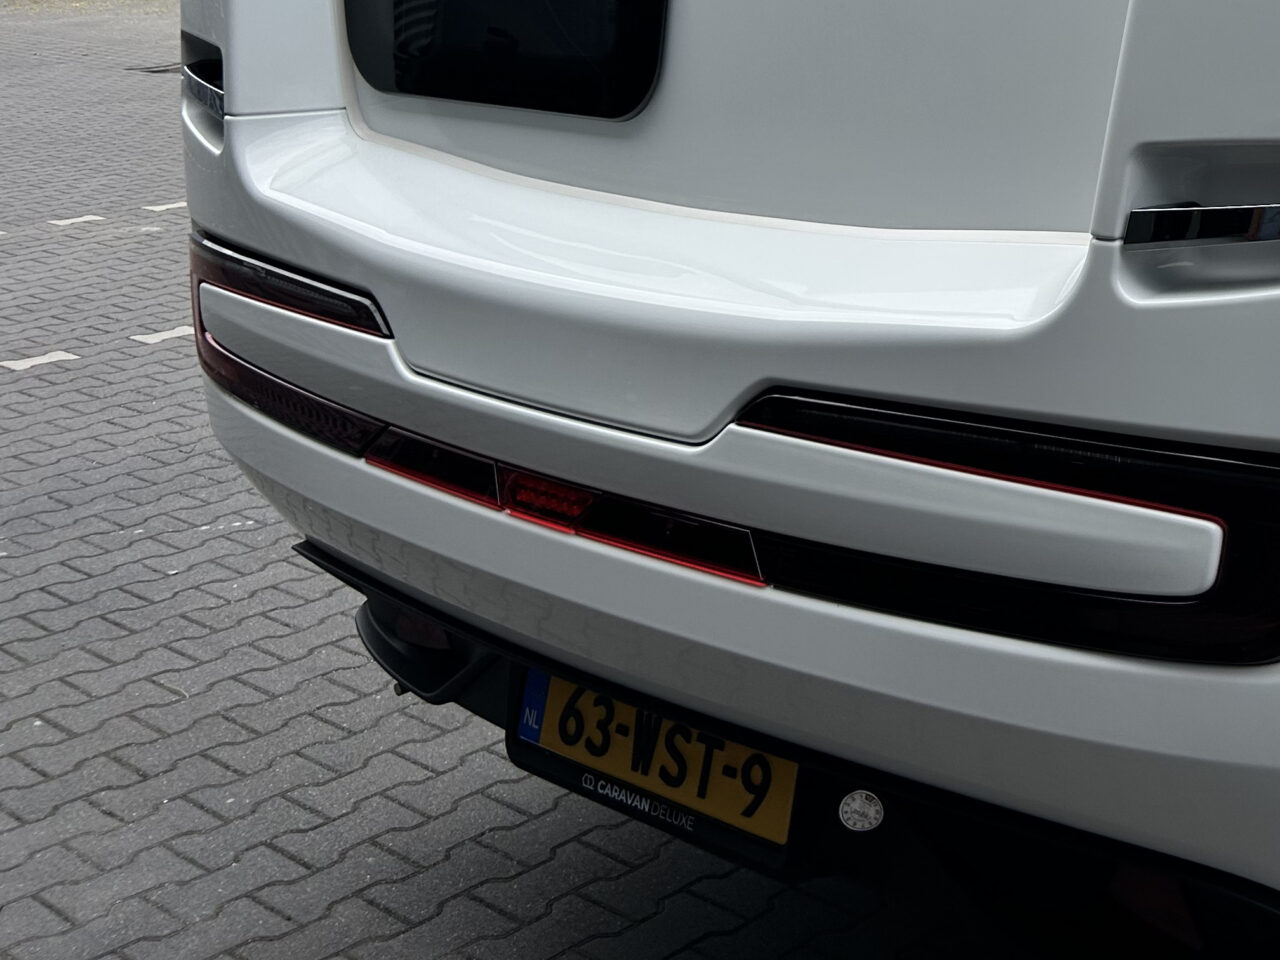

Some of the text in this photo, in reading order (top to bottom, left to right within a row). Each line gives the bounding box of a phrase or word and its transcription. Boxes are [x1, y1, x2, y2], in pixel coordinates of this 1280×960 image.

[523, 706, 539, 730] NL
[558, 686, 772, 818] 63-WST-9
[596, 780, 696, 831] CARAVAN DELUXE
